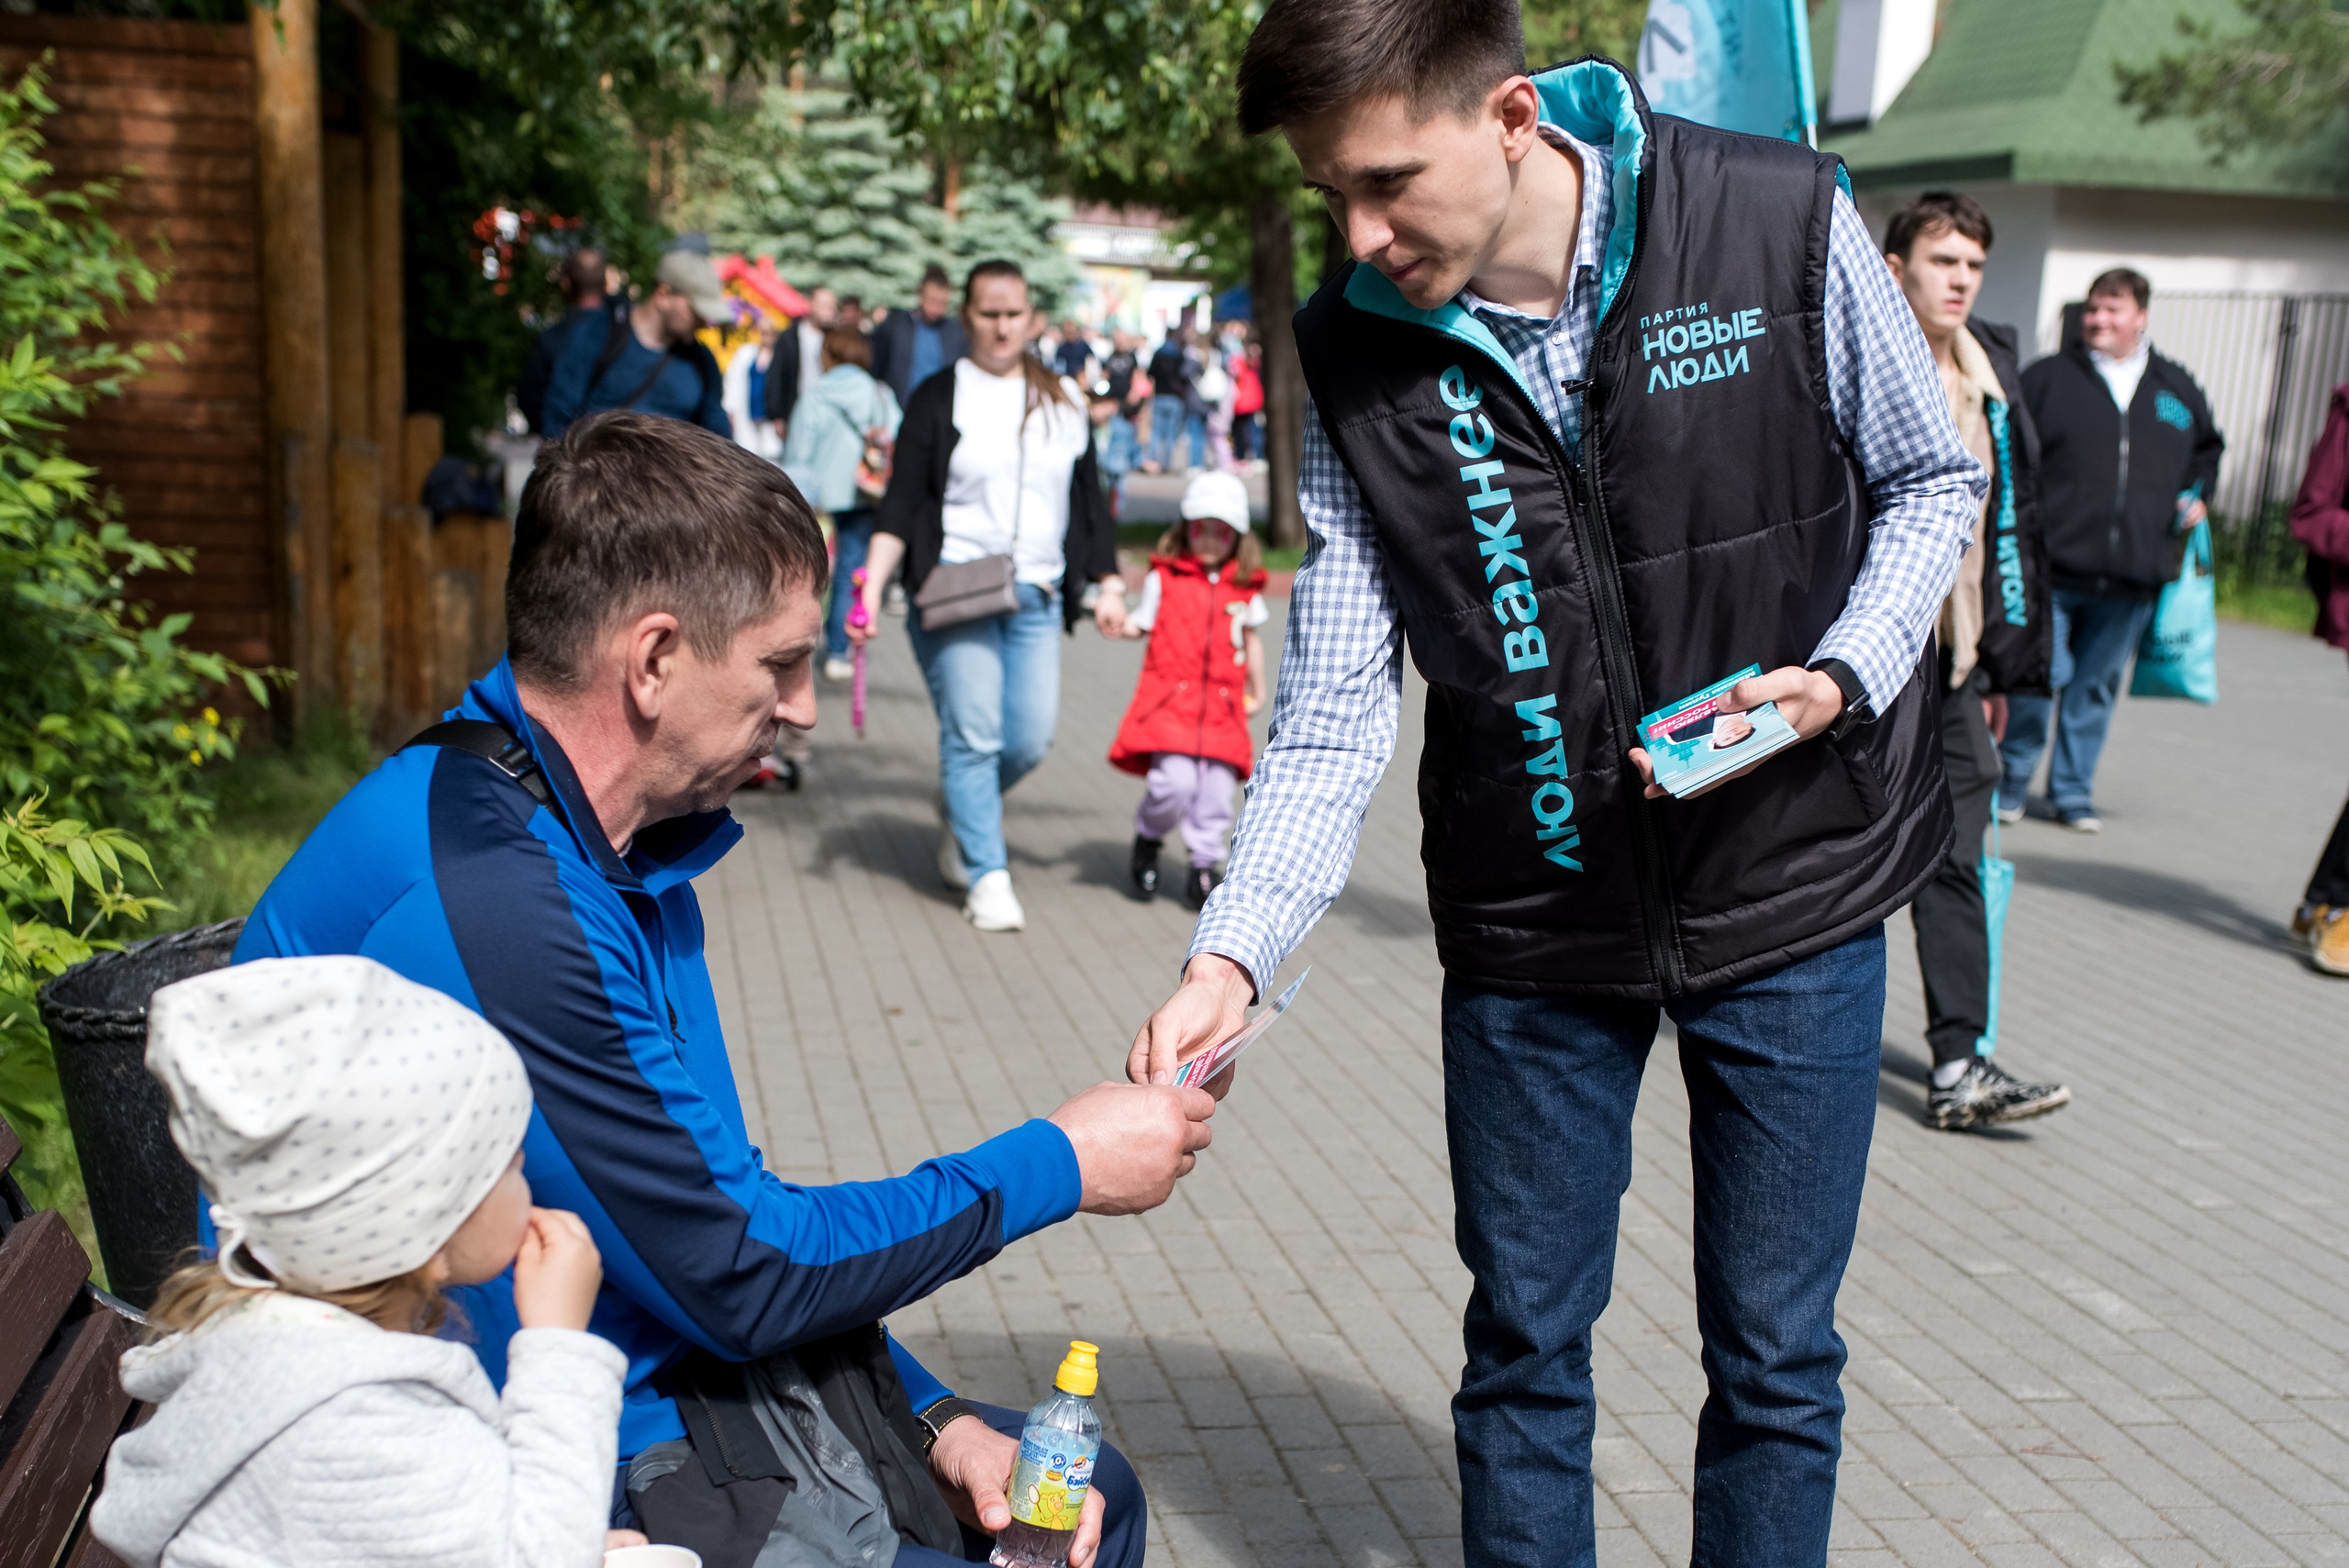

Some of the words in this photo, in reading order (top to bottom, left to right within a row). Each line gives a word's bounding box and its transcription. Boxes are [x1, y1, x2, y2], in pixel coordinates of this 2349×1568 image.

[1640, 301, 1709, 329] ПАРТИЯ
[1642, 307, 1766, 361] НОВЫЕ
[1647, 345, 1750, 395] ЛЮДИ
